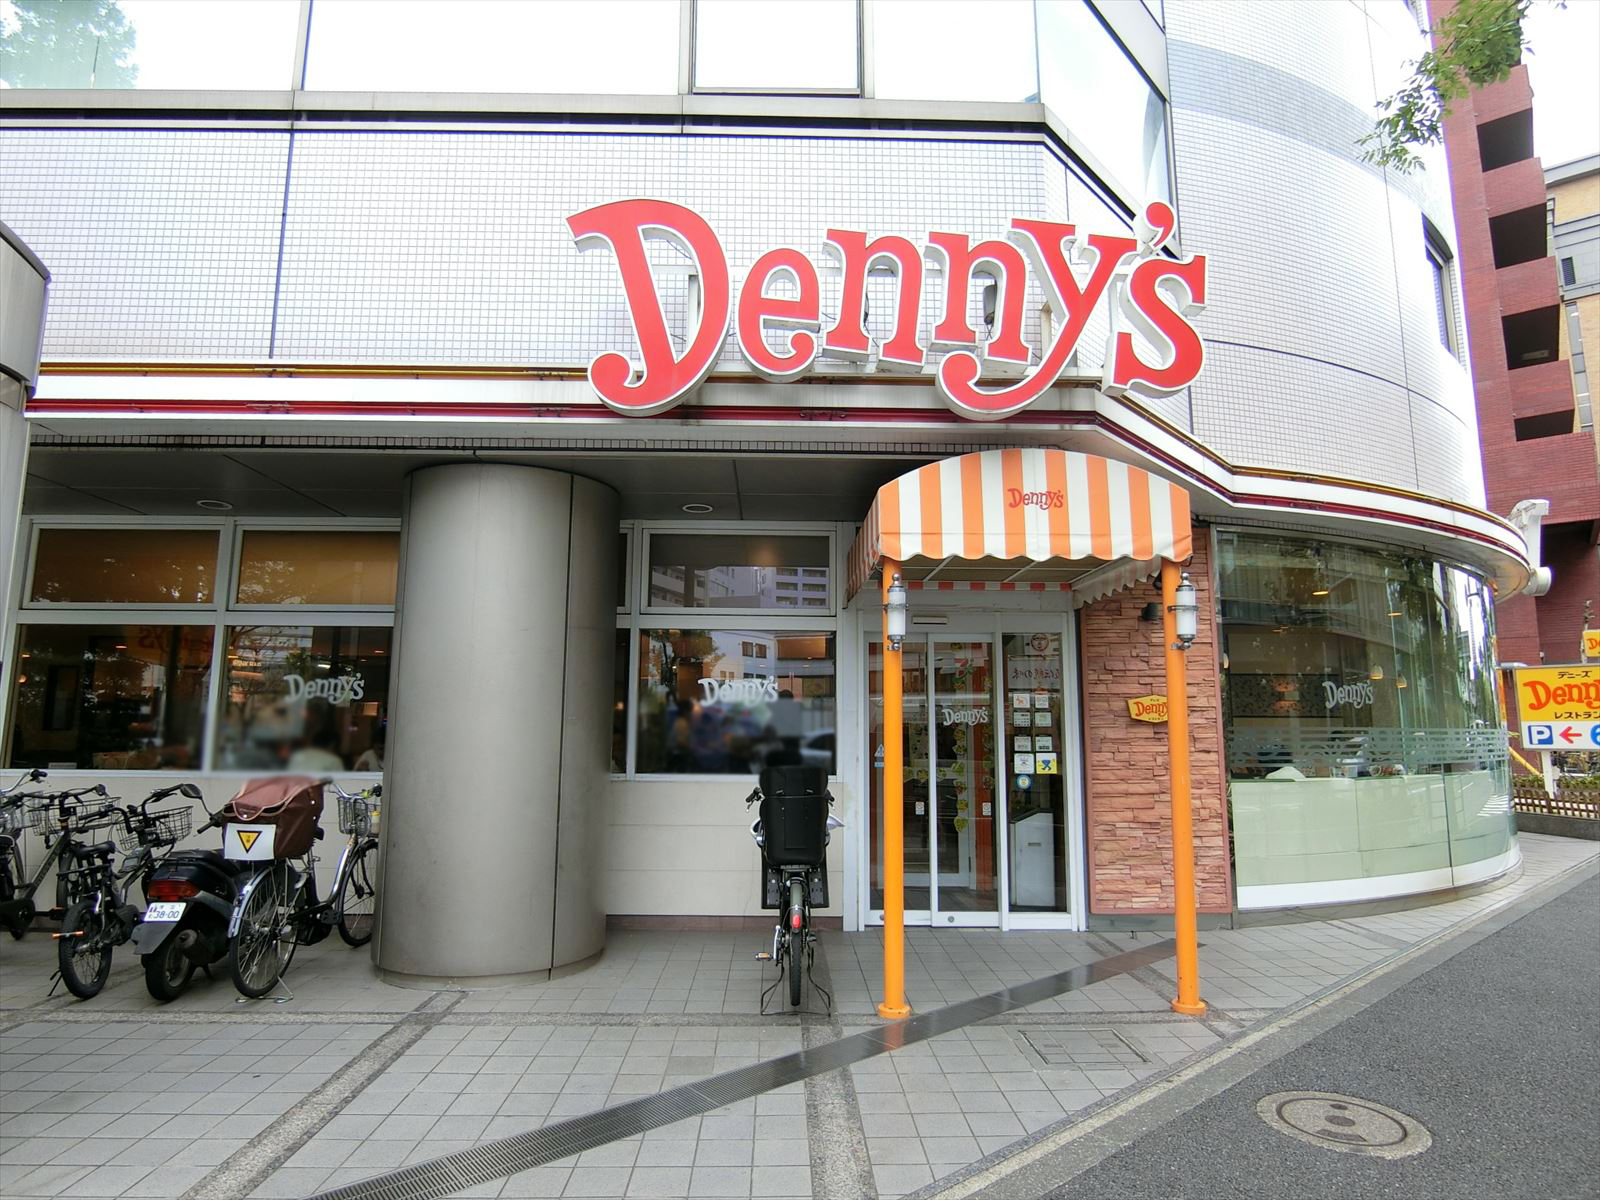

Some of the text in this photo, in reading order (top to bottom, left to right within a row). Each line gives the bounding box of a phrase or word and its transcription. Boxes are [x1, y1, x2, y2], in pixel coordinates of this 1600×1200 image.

[565, 199, 1207, 419] Denny's
[1007, 488, 1064, 511] Denny's
[284, 673, 365, 705] Denny's
[1557, 670, 1592, 679] デニーズ
[697, 675, 779, 708] Denny's
[1322, 680, 1374, 709] Denny's
[941, 706, 988, 726] Denny's
